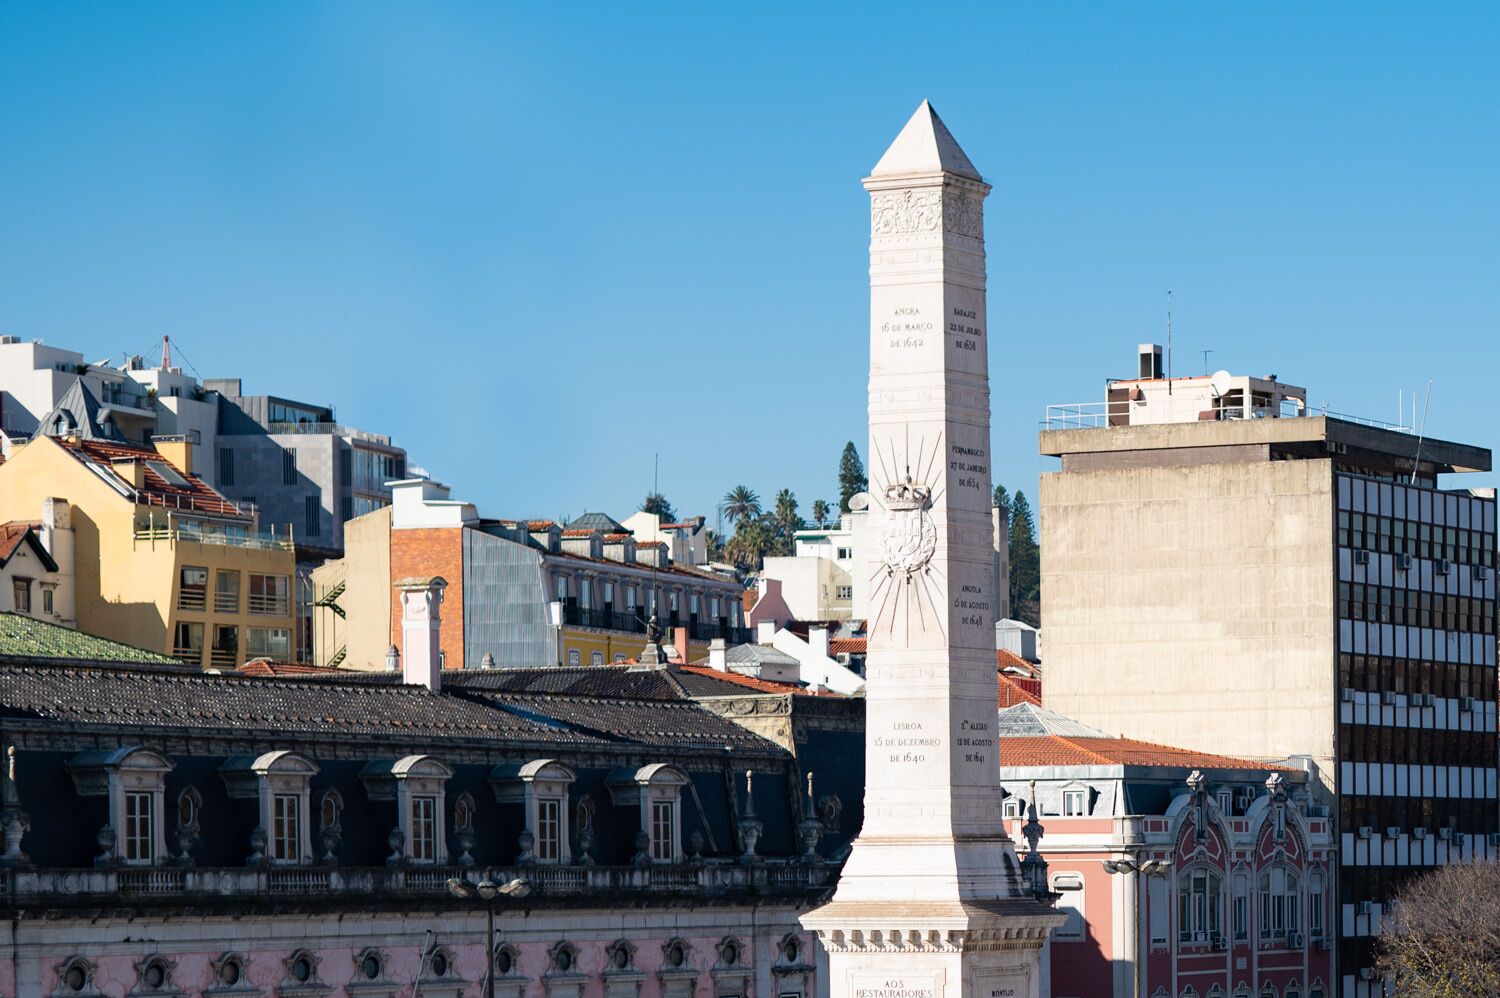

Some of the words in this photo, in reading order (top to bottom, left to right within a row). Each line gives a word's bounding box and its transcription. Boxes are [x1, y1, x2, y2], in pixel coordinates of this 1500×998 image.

[894, 307, 920, 316] ANGRA
[881, 322, 890, 333] 16
[892, 323, 902, 332] DE
[904, 322, 933, 334] MARÇO
[958, 324, 965, 333] DE
[890, 340, 901, 348] DE
[903, 337, 924, 350] 1642
[956, 341, 963, 349] DE
[952, 445, 985, 457] PERNAMBUCO
[958, 463, 966, 471] DE
[959, 479, 966, 487] DE
[962, 585, 982, 594] ANGOLA
[961, 601, 968, 609] DE
[969, 601, 989, 610] AGOSTO
[962, 617, 969, 625] DE
[893, 721, 922, 731] LISBOA
[874, 738, 883, 747] 15
[885, 738, 896, 747] DE
[898, 737, 941, 749] DEZEMBRO
[964, 738, 971, 747] DE
[972, 739, 993, 747] AGOSTO
[890, 754, 901, 763] DE
[903, 751, 925, 764] 1640
[966, 754, 973, 762] DE
[885, 979, 904, 988] AOS
[856, 989, 933, 998] RESTAURADORES
[991, 989, 1015, 998] MONTIJO
